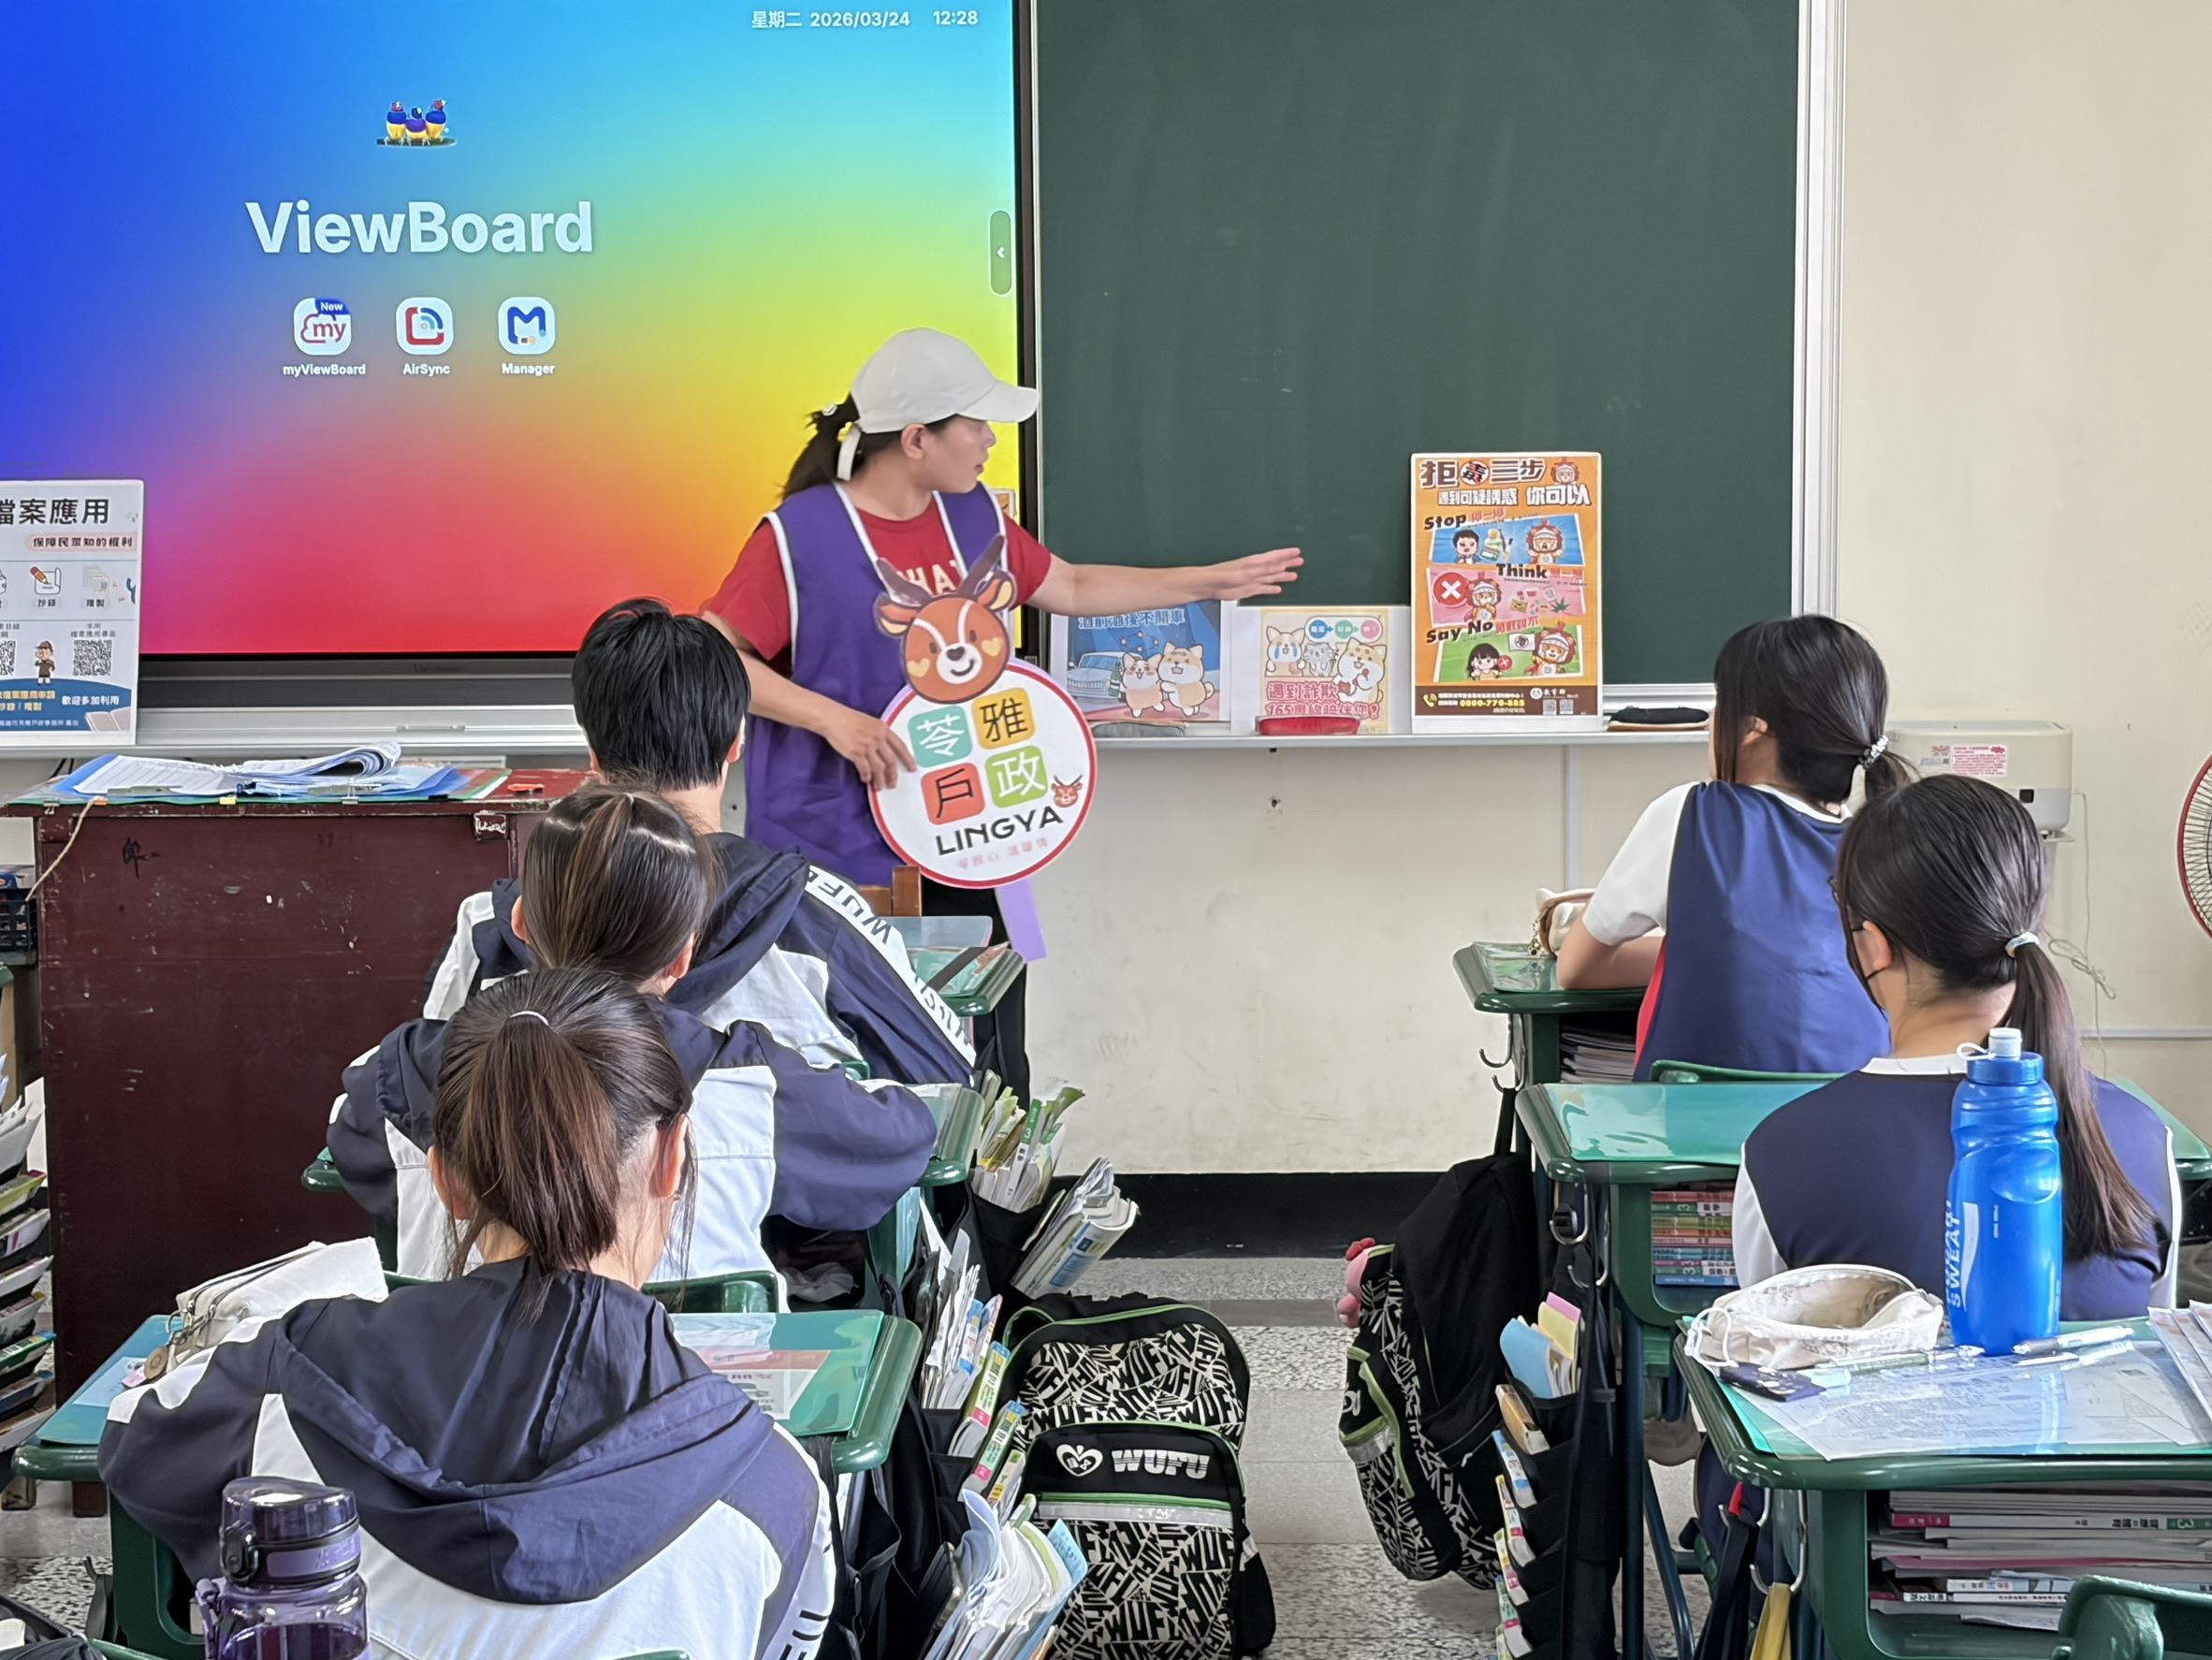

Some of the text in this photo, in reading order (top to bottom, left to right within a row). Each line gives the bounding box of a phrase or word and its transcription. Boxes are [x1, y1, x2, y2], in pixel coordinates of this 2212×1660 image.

[751, 10, 979, 29] 星期二 2026/03/24 12:28
[246, 199, 593, 255] ViewBoard
[320, 301, 343, 312] New
[313, 323, 346, 343] my
[283, 363, 367, 378] myViewBoard
[402, 362, 451, 377] AirSync
[501, 362, 555, 377] Manager
[1525, 484, 1592, 507] 你可以
[1424, 514, 1467, 531] Stop
[1496, 563, 1549, 579] Think
[1426, 626, 1463, 644] Say
[1467, 619, 1494, 635] No
[936, 808, 1064, 855] LINGYA
[1949, 1216, 1961, 1309] SWEAT
[1111, 1449, 1211, 1479] WUFU
